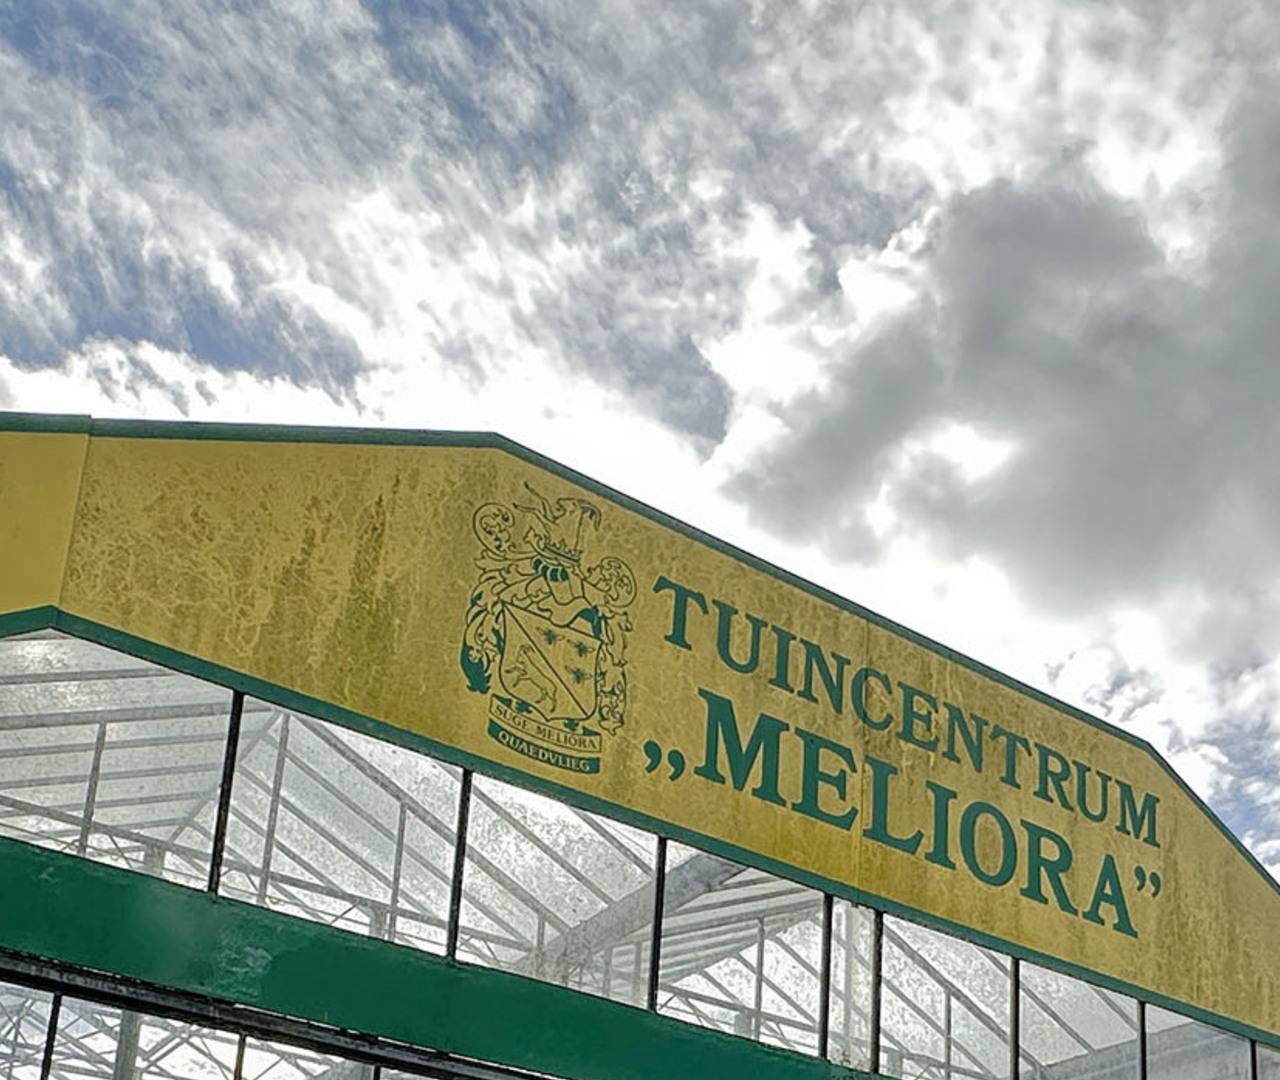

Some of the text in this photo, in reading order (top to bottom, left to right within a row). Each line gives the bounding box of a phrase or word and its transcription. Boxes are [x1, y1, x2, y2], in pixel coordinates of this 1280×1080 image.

[495, 704, 597, 750] SUGE MELIORA
[653, 575, 1161, 848] TUINCENTRUM
[498, 731, 590, 772] QUAEDVLIEG
